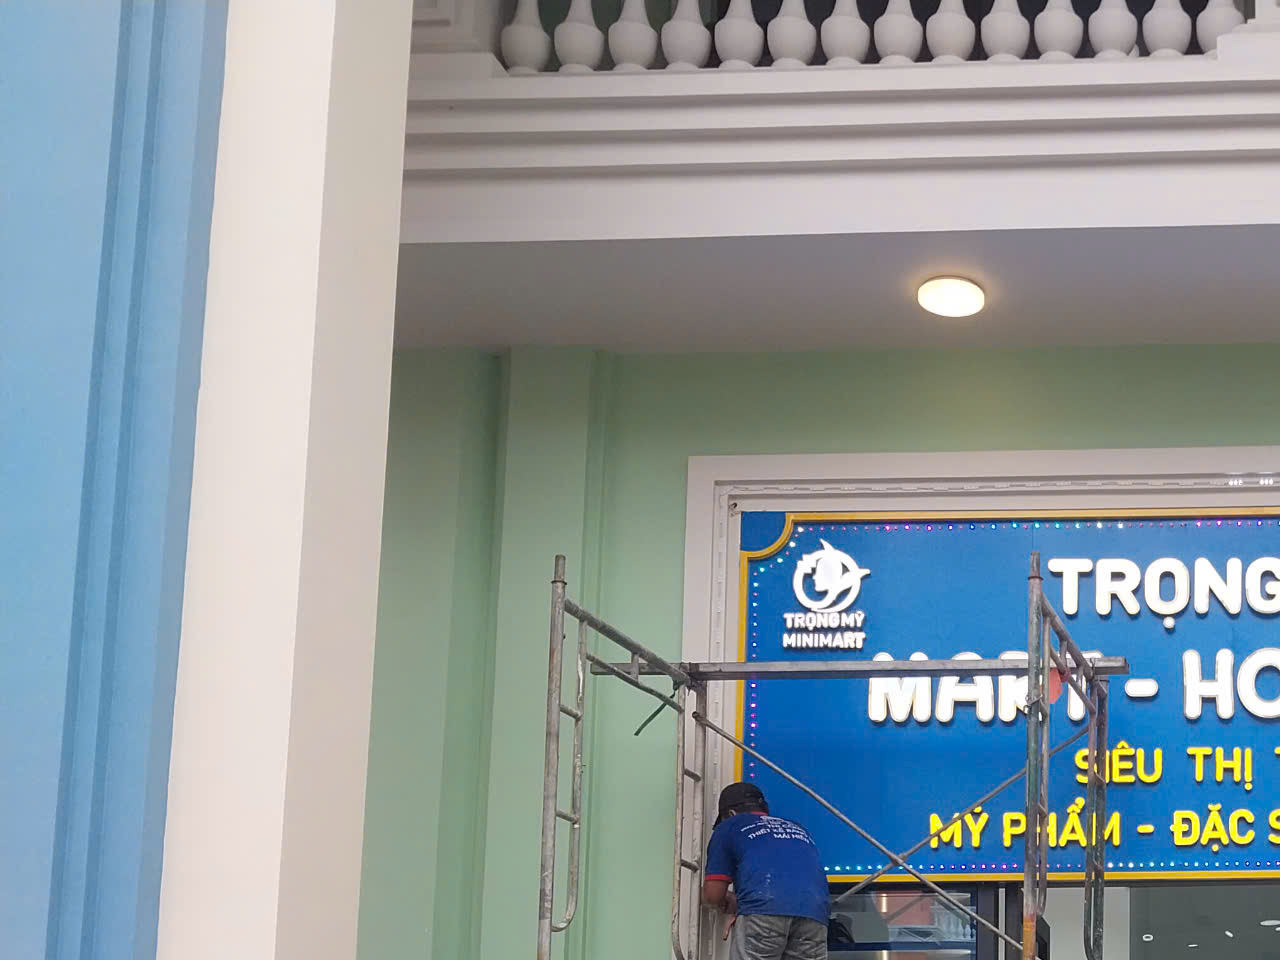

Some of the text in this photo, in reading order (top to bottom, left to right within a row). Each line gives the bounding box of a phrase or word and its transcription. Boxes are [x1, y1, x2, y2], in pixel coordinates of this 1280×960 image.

[782, 631, 866, 649] MINIMART
[1187, 747, 1254, 791] THỊ
[1170, 803, 1256, 852] ĐẶC
